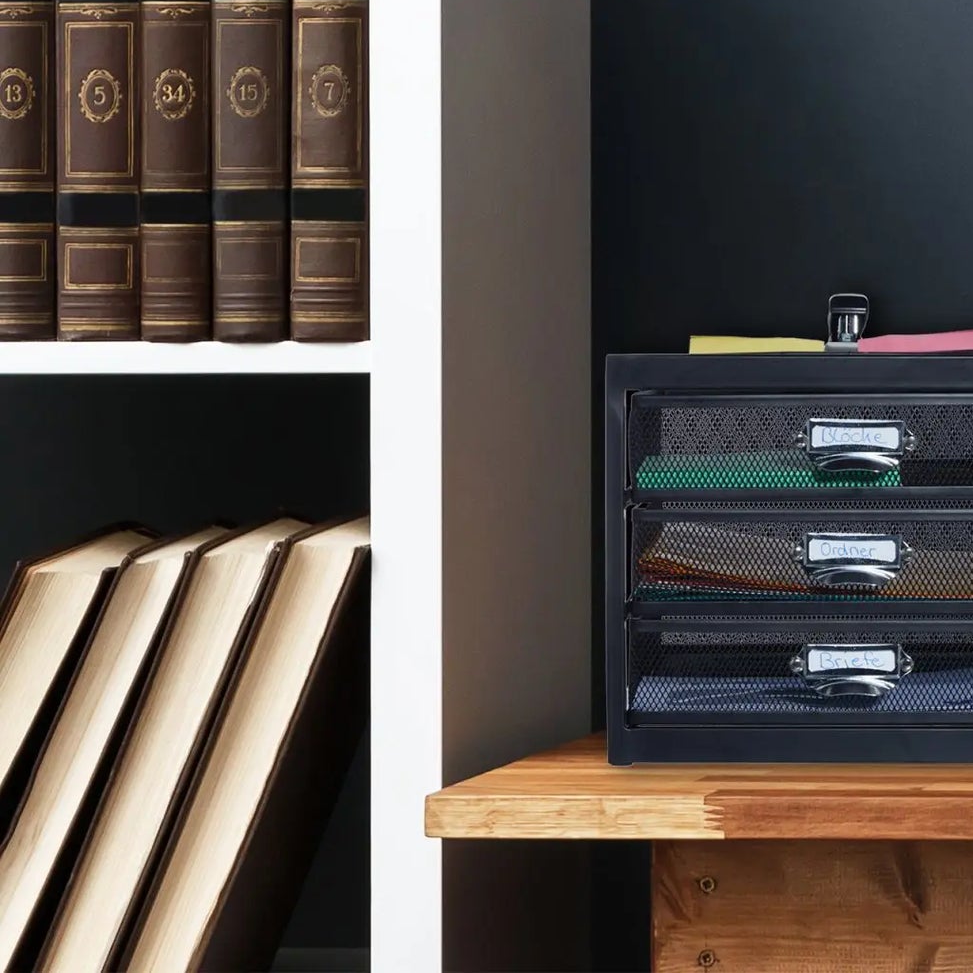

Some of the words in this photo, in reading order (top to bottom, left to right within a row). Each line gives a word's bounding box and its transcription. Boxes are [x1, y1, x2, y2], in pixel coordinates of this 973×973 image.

[4, 84, 22, 103] 13
[93, 86, 106, 105] 5
[162, 84, 186, 103] 34
[238, 84, 258, 101] 15
[324, 82, 335, 101] 7
[820, 542, 877, 558] Ordner
[820, 651, 885, 670] Briefe
